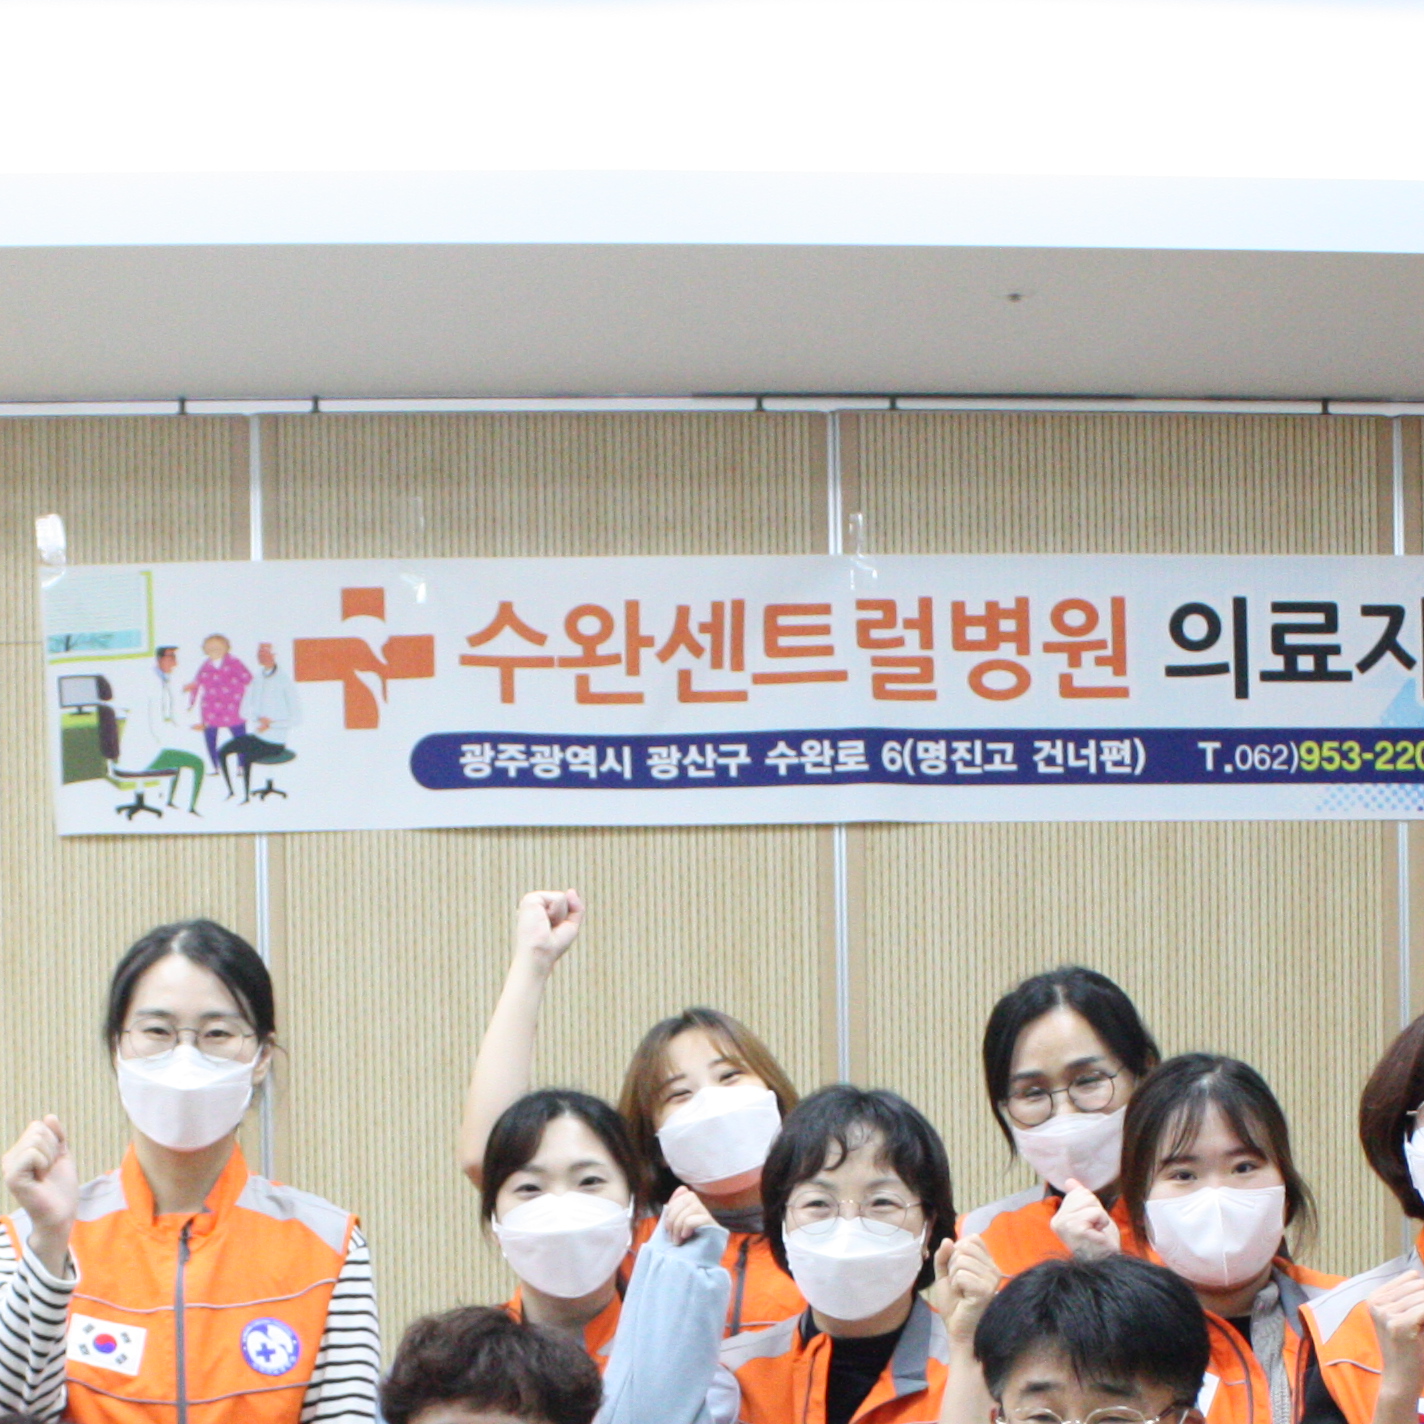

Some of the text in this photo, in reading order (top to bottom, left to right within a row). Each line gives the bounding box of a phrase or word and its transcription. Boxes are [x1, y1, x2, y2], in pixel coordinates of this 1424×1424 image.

[460, 596, 1130, 706] 수완센트럴병원
[459, 742, 632, 780] 광주광역시
[646, 743, 753, 780] 광산구
[764, 739, 870, 776] 수완로
[881, 738, 1018, 776] 6(명진고
[1032, 737, 1146, 776] 건너편)
